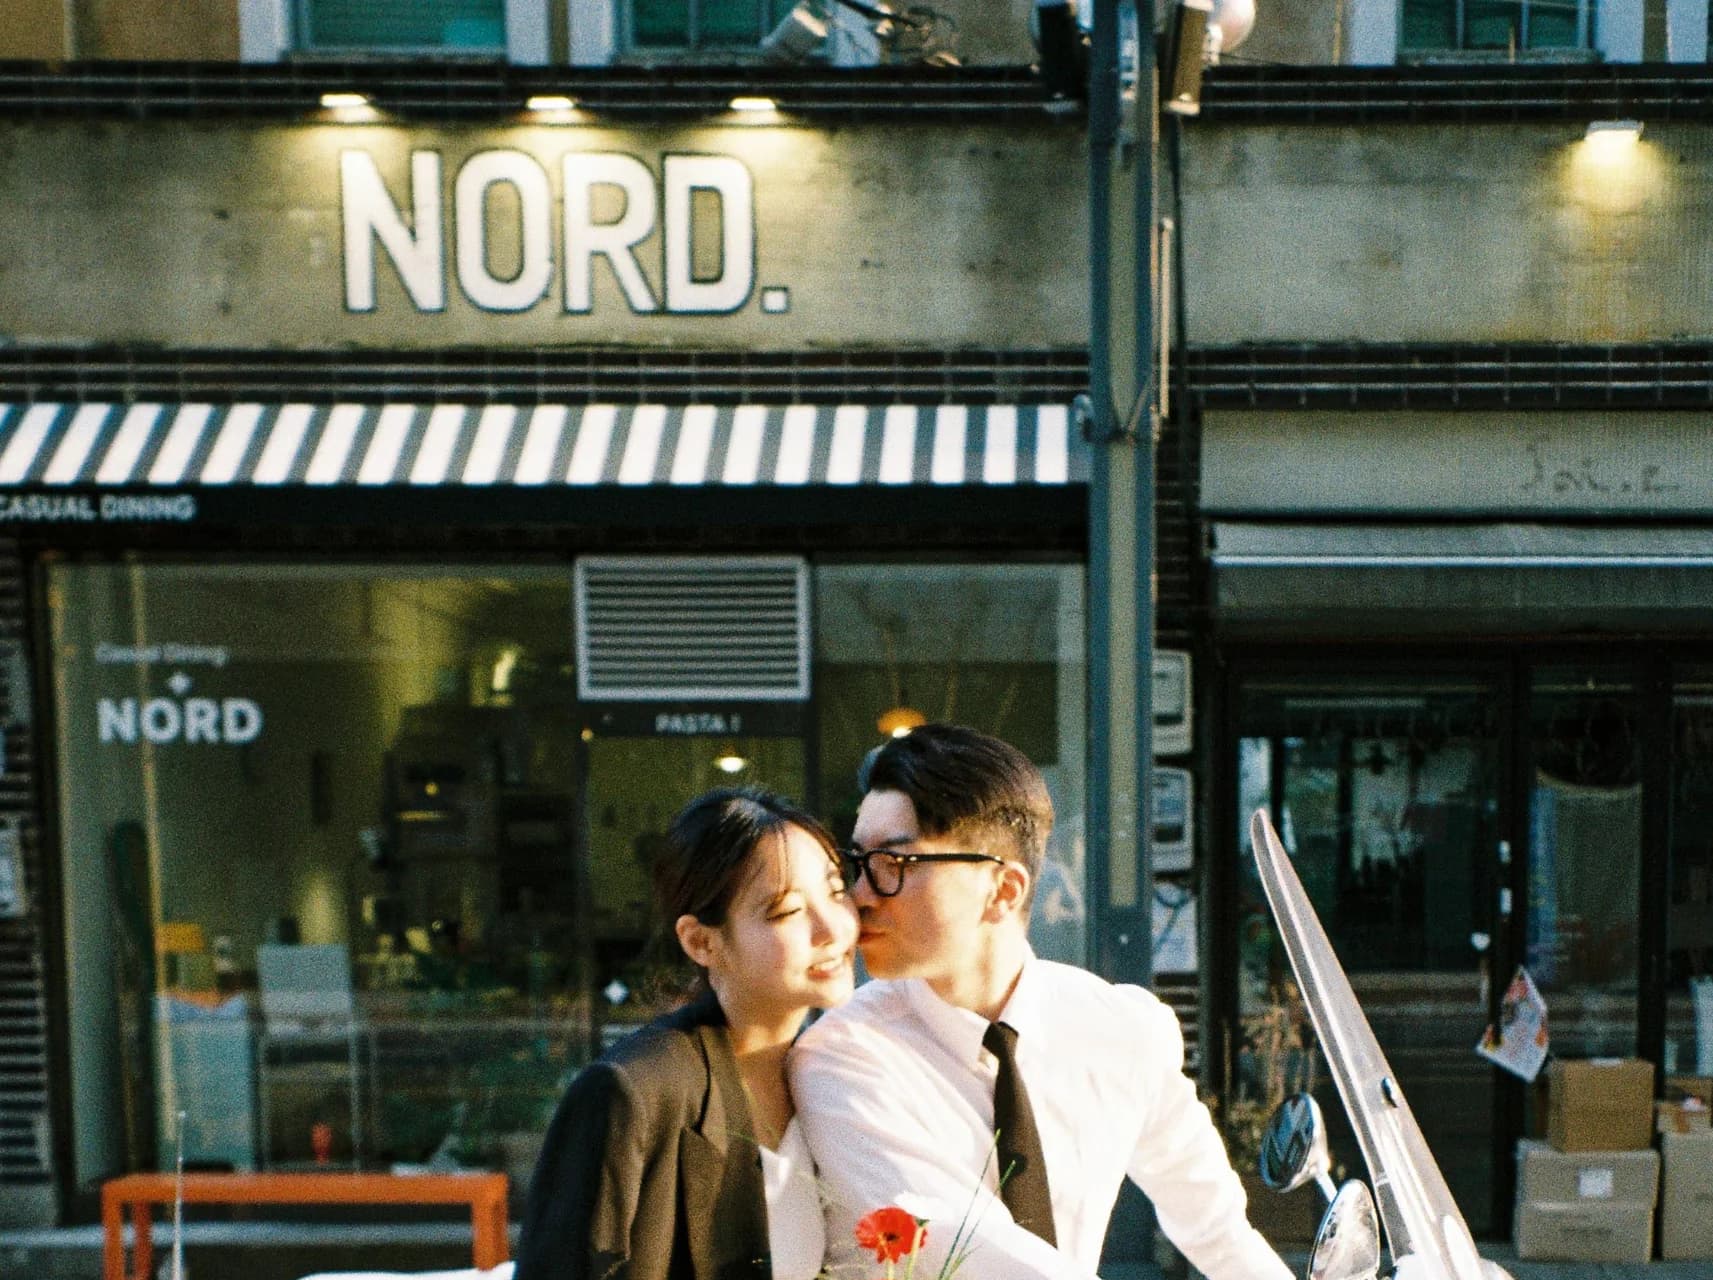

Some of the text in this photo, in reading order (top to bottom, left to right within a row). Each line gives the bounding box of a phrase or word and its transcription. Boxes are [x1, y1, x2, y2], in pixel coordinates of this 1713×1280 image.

[339, 147, 789, 315] NORD.
[101, 493, 196, 521] DINING
[97, 696, 263, 745] NORD
